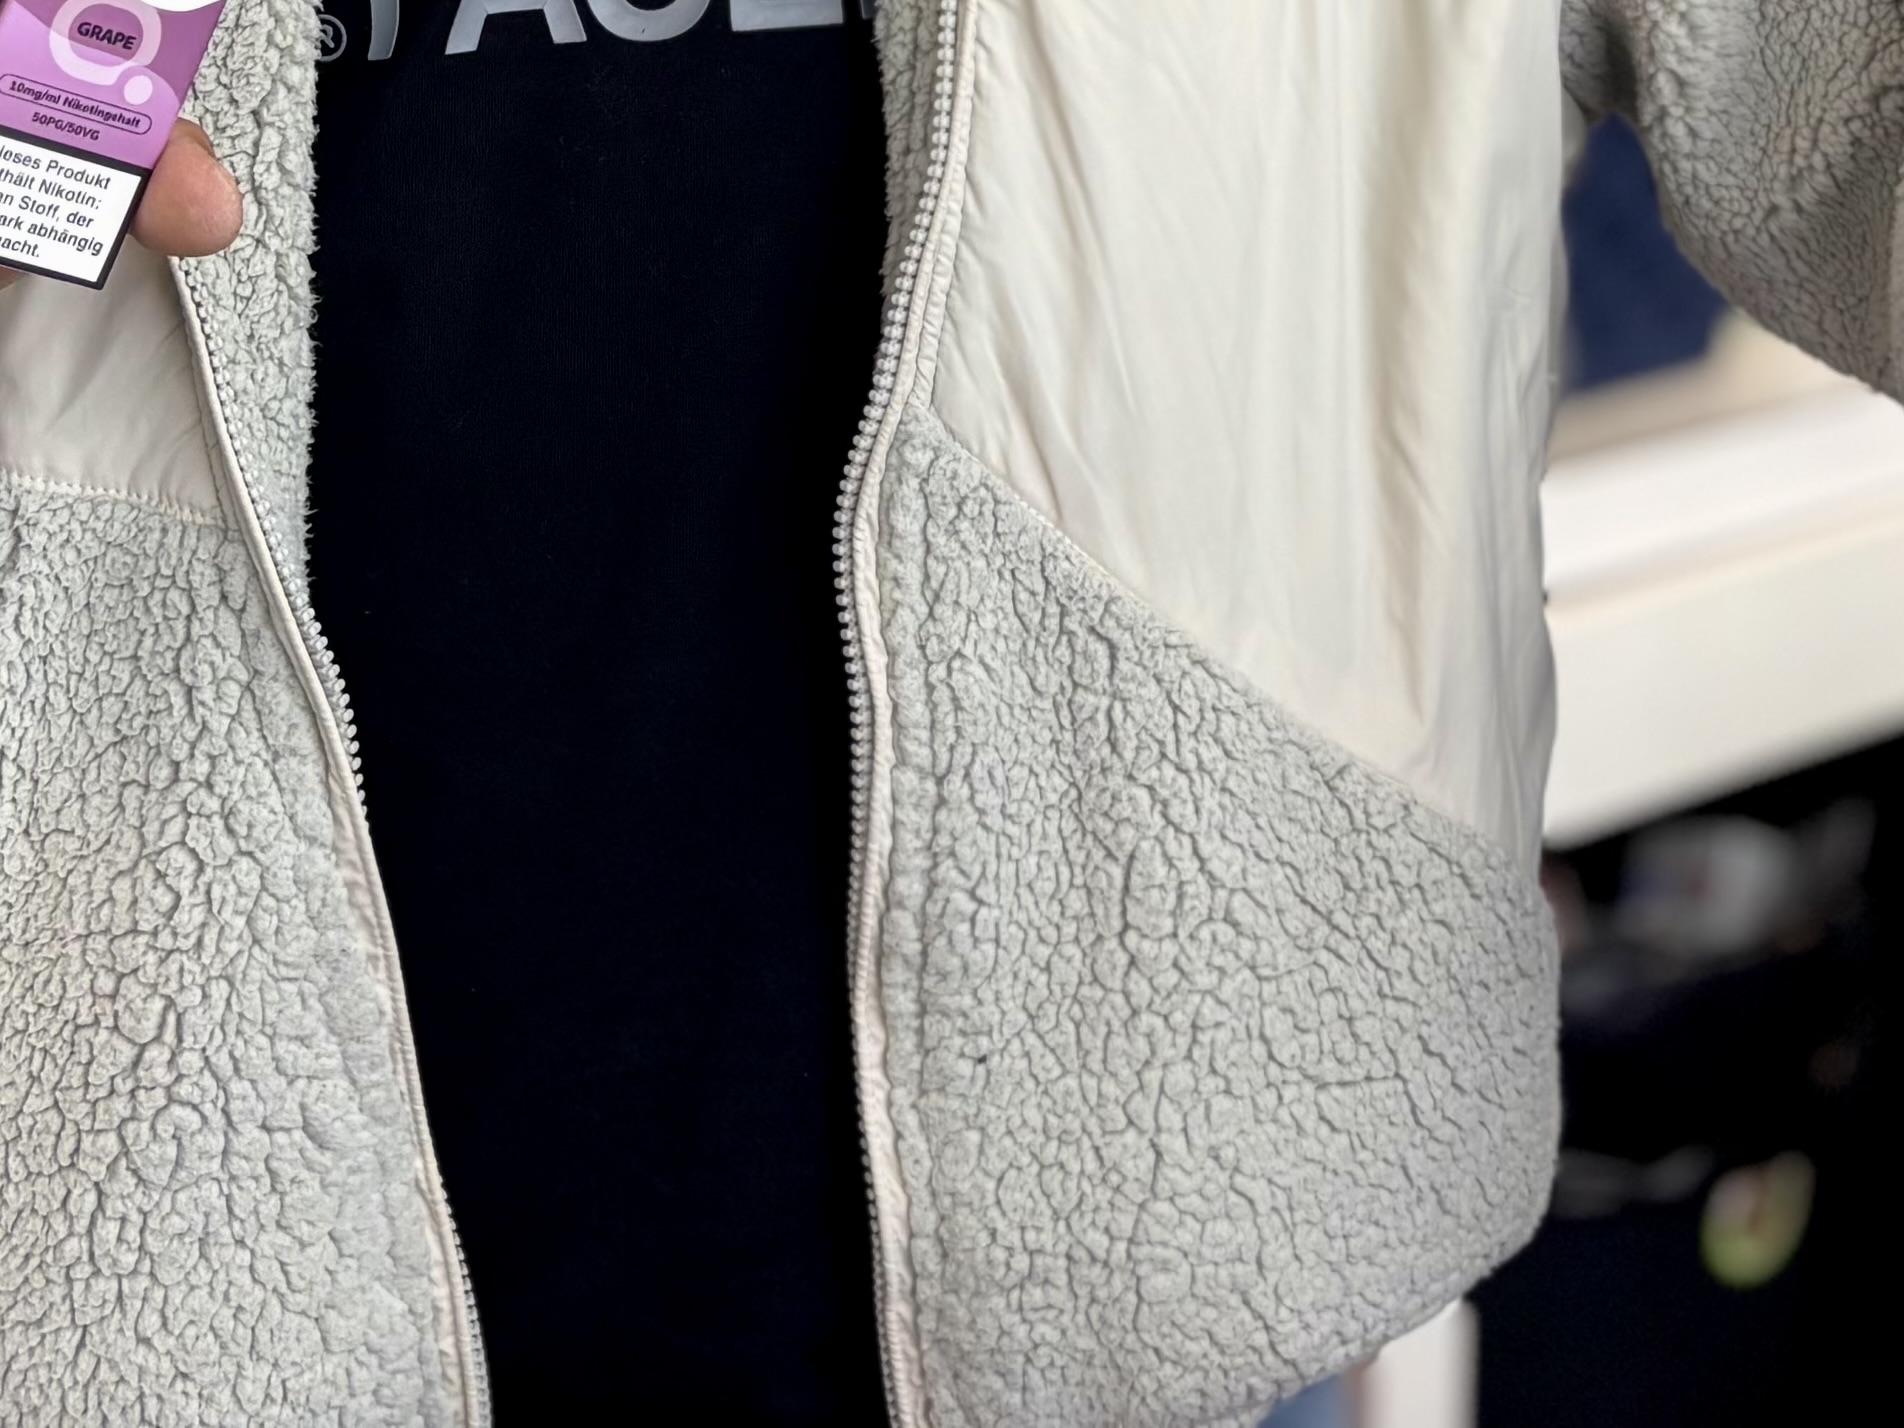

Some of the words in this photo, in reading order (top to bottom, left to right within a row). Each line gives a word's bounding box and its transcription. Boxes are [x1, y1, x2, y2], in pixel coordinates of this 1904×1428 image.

[76, 20, 138, 51] GRAPE
[9, 80, 62, 106] 10mg/ml
[62, 96, 142, 129] Nikotingehalt
[31, 111, 101, 142] 50PG/50VG
[45, 158, 113, 191] Produkt
[66, 208, 95, 230] der
[26, 221, 104, 257] abhängig
